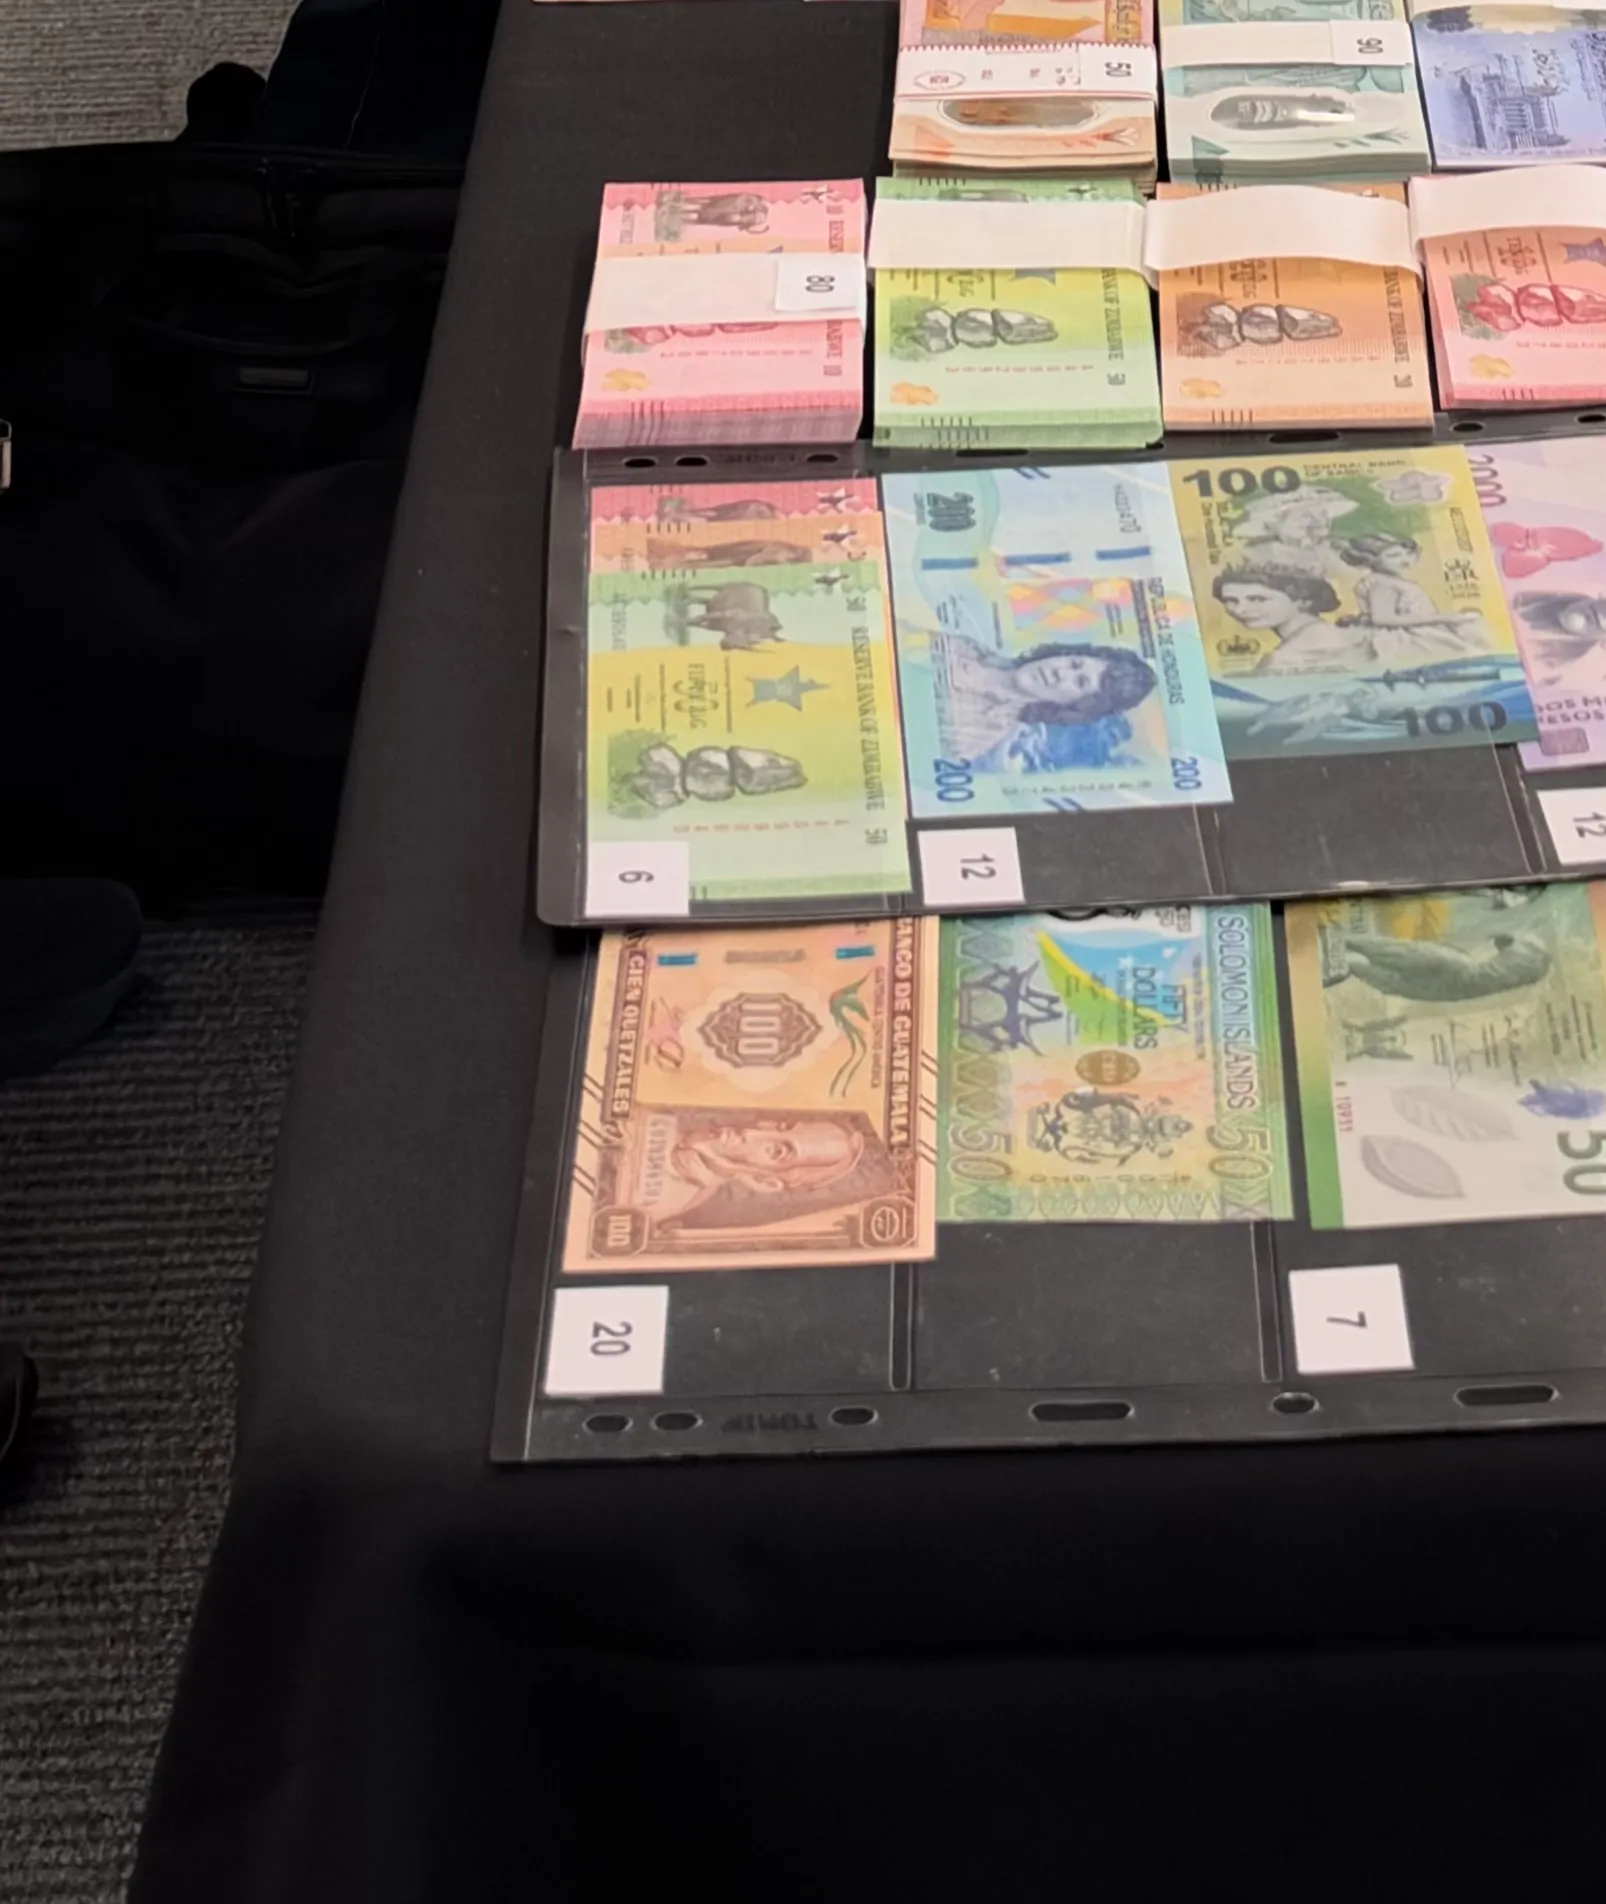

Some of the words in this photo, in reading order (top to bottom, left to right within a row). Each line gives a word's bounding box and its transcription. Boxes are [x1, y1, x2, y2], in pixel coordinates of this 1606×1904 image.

[1357, 38, 1383, 53] 90
[1105, 62, 1131, 76] 50
[806, 276, 835, 292] 80
[1182, 464, 1302, 498] 100
[925, 492, 977, 533] 200
[850, 626, 874, 684] RESERVE
[856, 683, 877, 718] BANK
[1398, 701, 1508, 737] 100
[860, 717, 877, 735] OF
[862, 737, 885, 812] ZIMBABWE
[933, 758, 975, 803] 200
[1169, 756, 1203, 791] 200
[619, 871, 654, 883] 6
[961, 855, 996, 879] 12
[622, 954, 645, 999] CIEN
[1216, 916, 1249, 1017] SOLOMON
[893, 982, 912, 1011] DE
[1132, 966, 1159, 1050] DOLLARS
[1162, 984, 1189, 1032] FIFTY
[737, 1001, 780, 1056] 100
[612, 1005, 639, 1115] QUETZALES
[889, 1014, 912, 1144] GUATEMALA
[1223, 1021, 1257, 1110] ISLANDS
[950, 1125, 1015, 1180] 50
[1206, 1125, 1274, 1179] 50
[608, 1215, 631, 1248] 100
[591, 1322, 632, 1355] 20
[1327, 1312, 1366, 1328] 7
